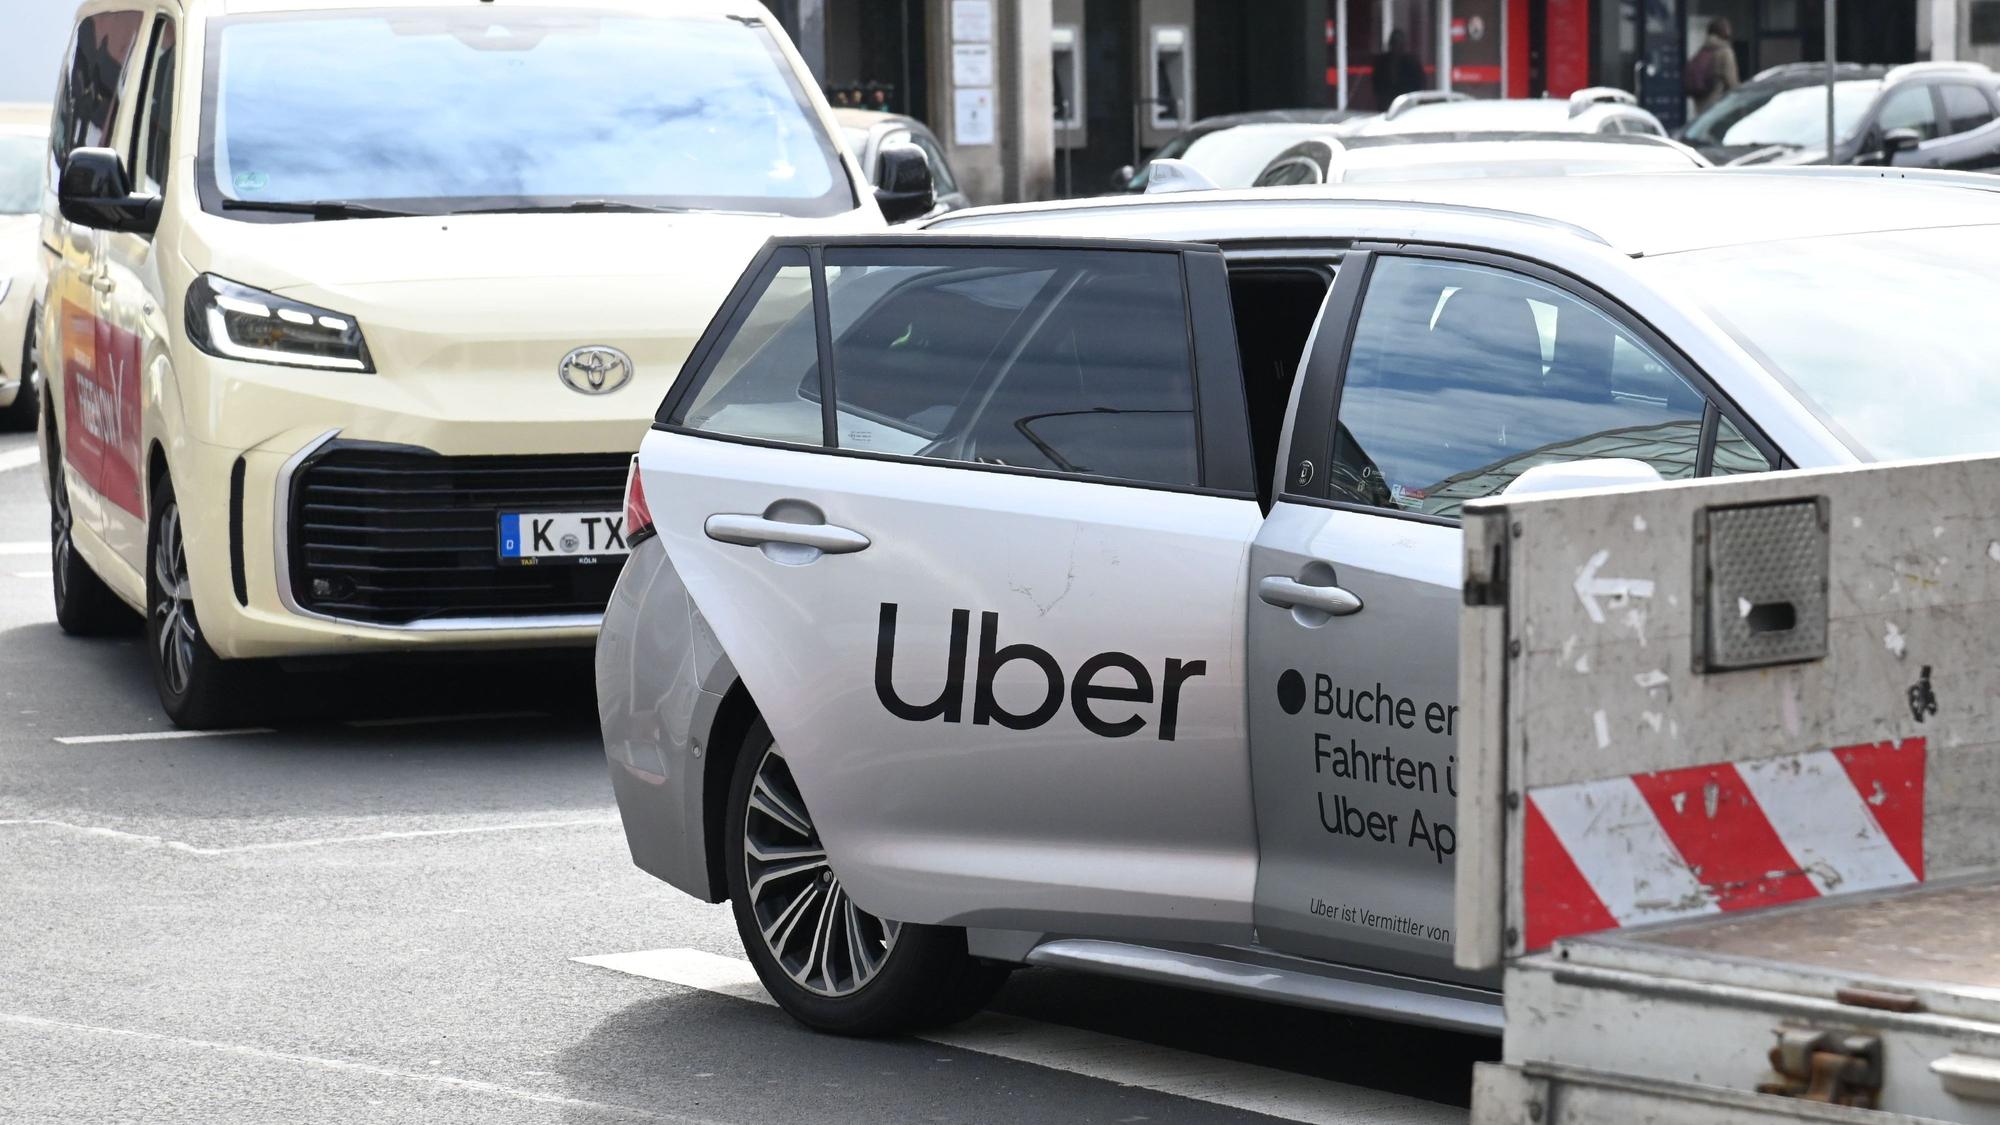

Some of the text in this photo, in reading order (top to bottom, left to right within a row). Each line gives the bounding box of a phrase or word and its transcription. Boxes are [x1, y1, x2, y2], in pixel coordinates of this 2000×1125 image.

[506, 516, 625, 552] D K TX
[579, 557, 597, 565] KÖLN
[875, 602, 1206, 741] Uber
[1314, 672, 1416, 729] Buche
[1314, 733, 1438, 793] Fahrten
[1317, 791, 1457, 864] Uber Ap
[1310, 898, 1450, 942] Uber ist Vermittler von
